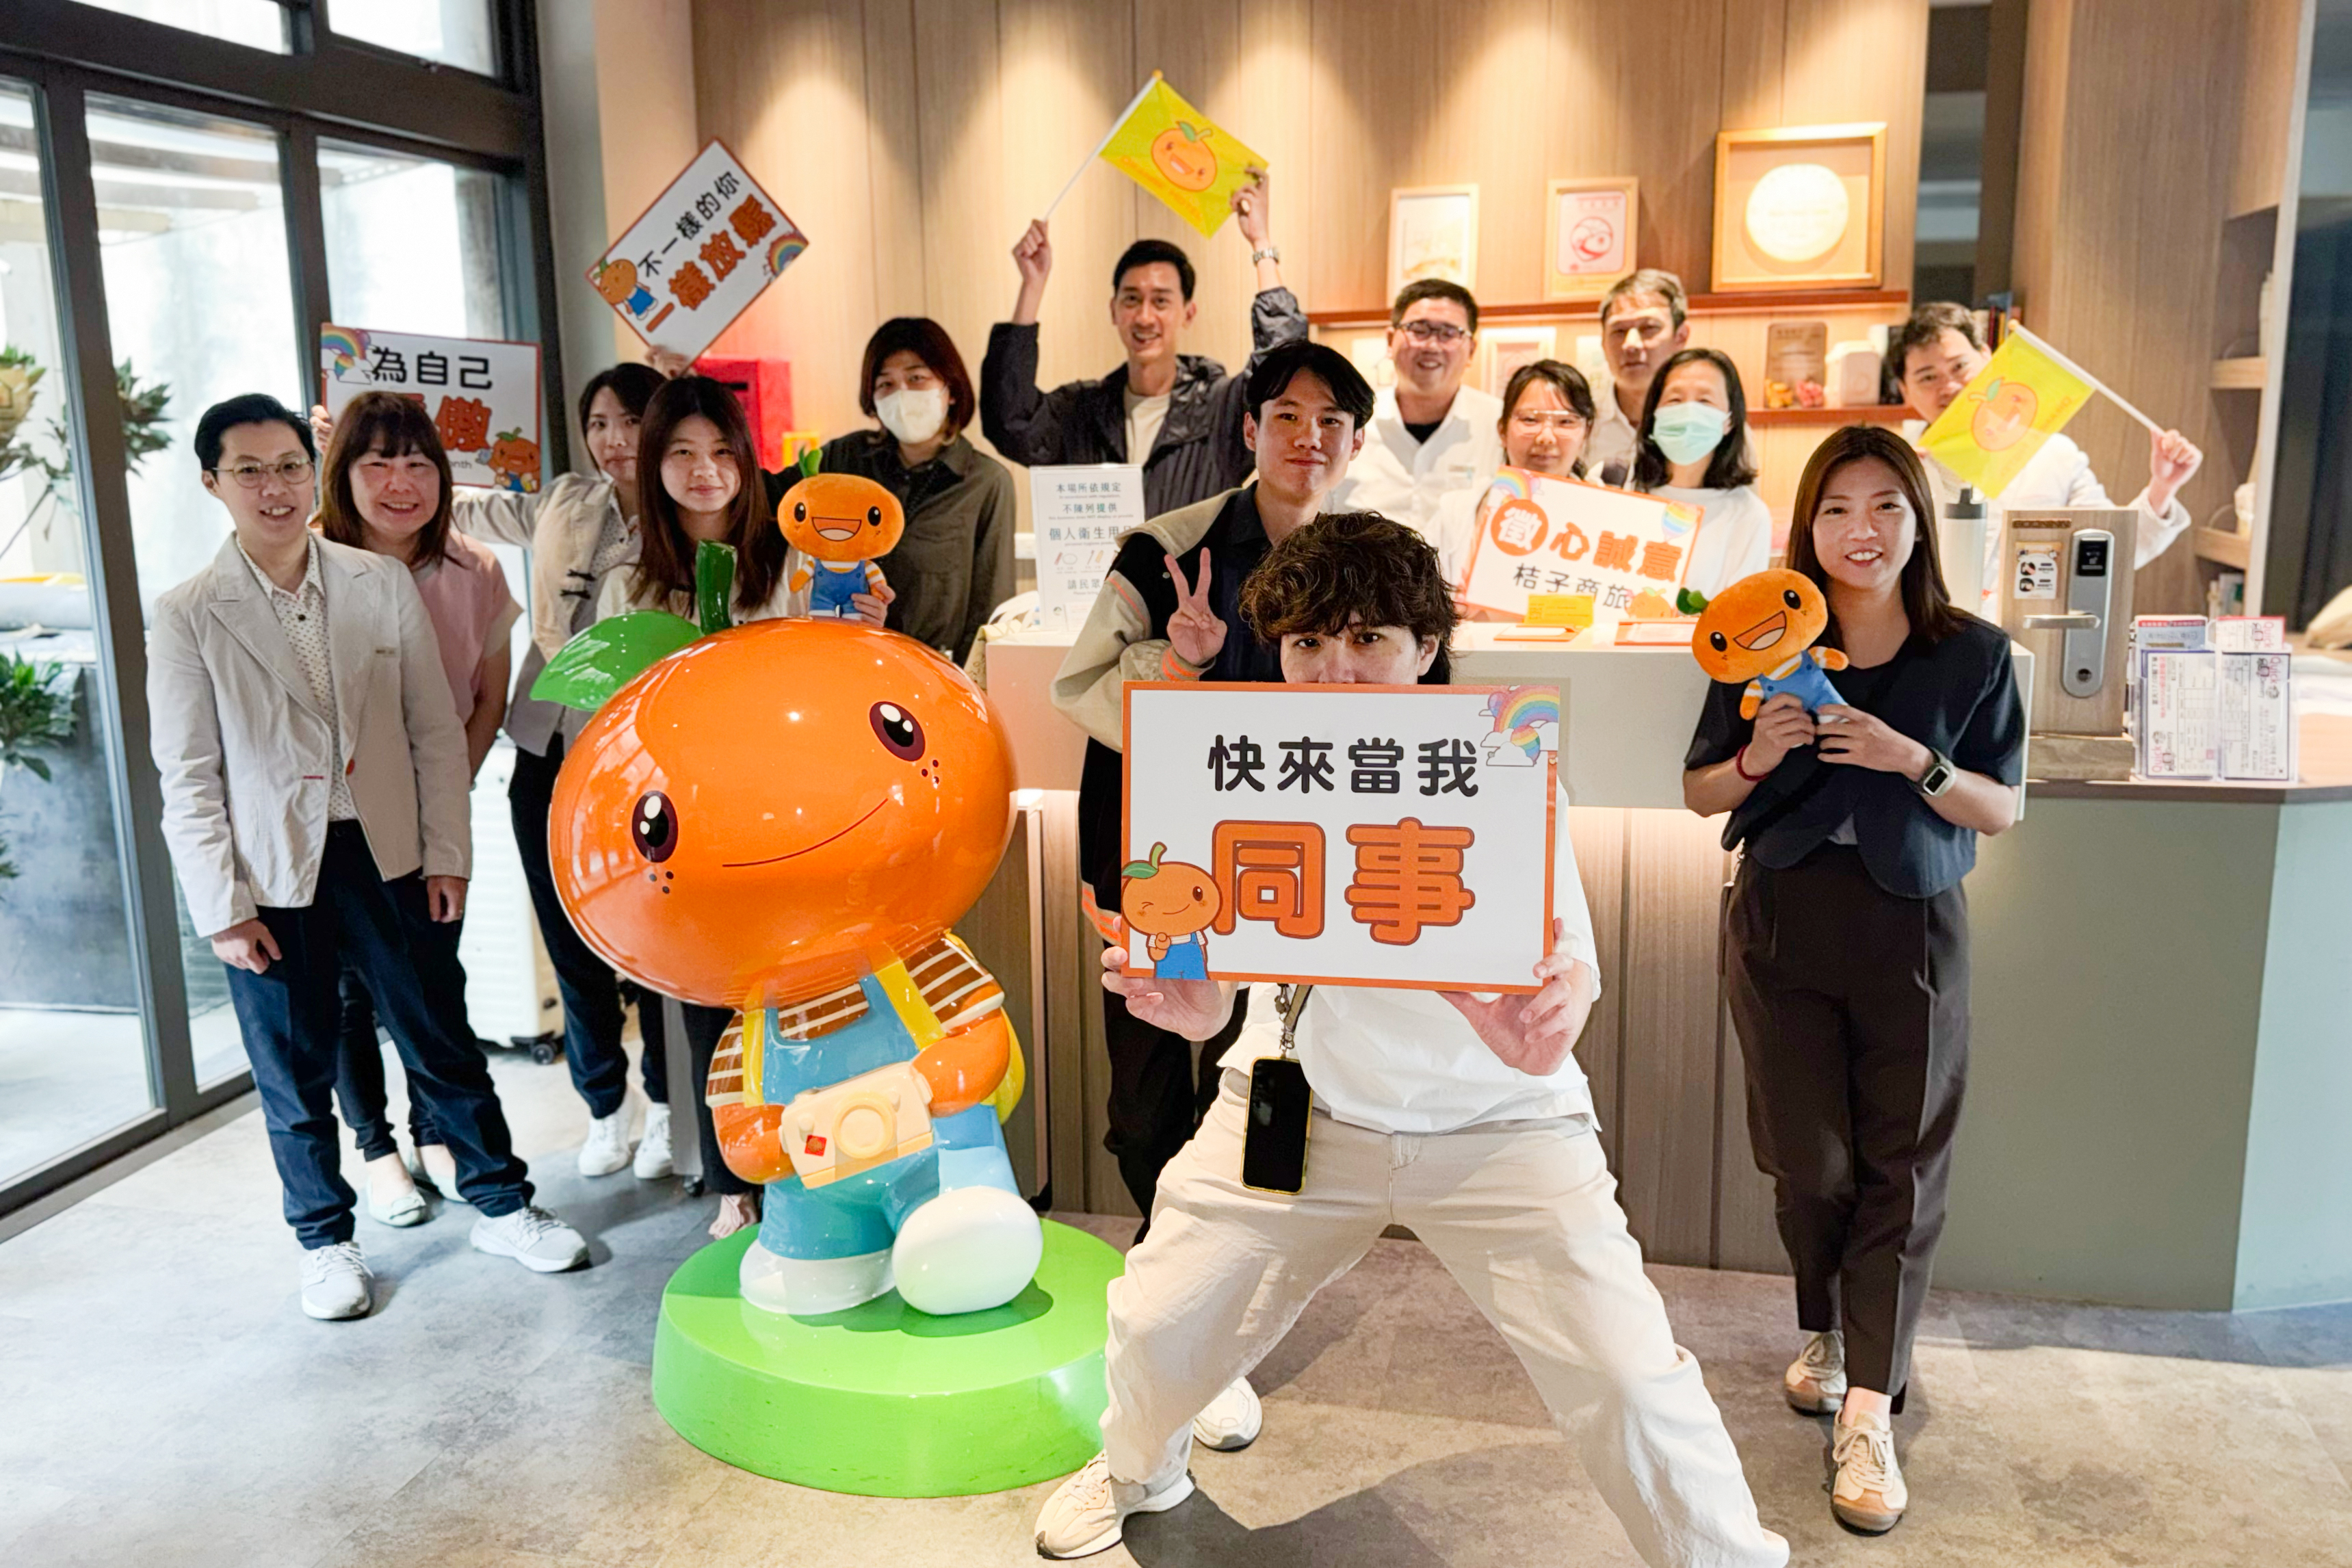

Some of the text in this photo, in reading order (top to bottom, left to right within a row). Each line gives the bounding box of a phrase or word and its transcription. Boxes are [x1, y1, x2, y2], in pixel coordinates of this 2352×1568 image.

[638, 171, 741, 277] 不一樣的你
[646, 194, 777, 332] 一樣放鬆
[371, 345, 493, 390] 為自己
[1056, 482, 1121, 493] 本場所依規定
[1062, 503, 1117, 514] 不陳列提供
[2270, 656, 2282, 683] Quick
[1207, 733, 1479, 797] 快來當我
[2152, 746, 2162, 772] Quick
[1212, 816, 1476, 946] 同事
